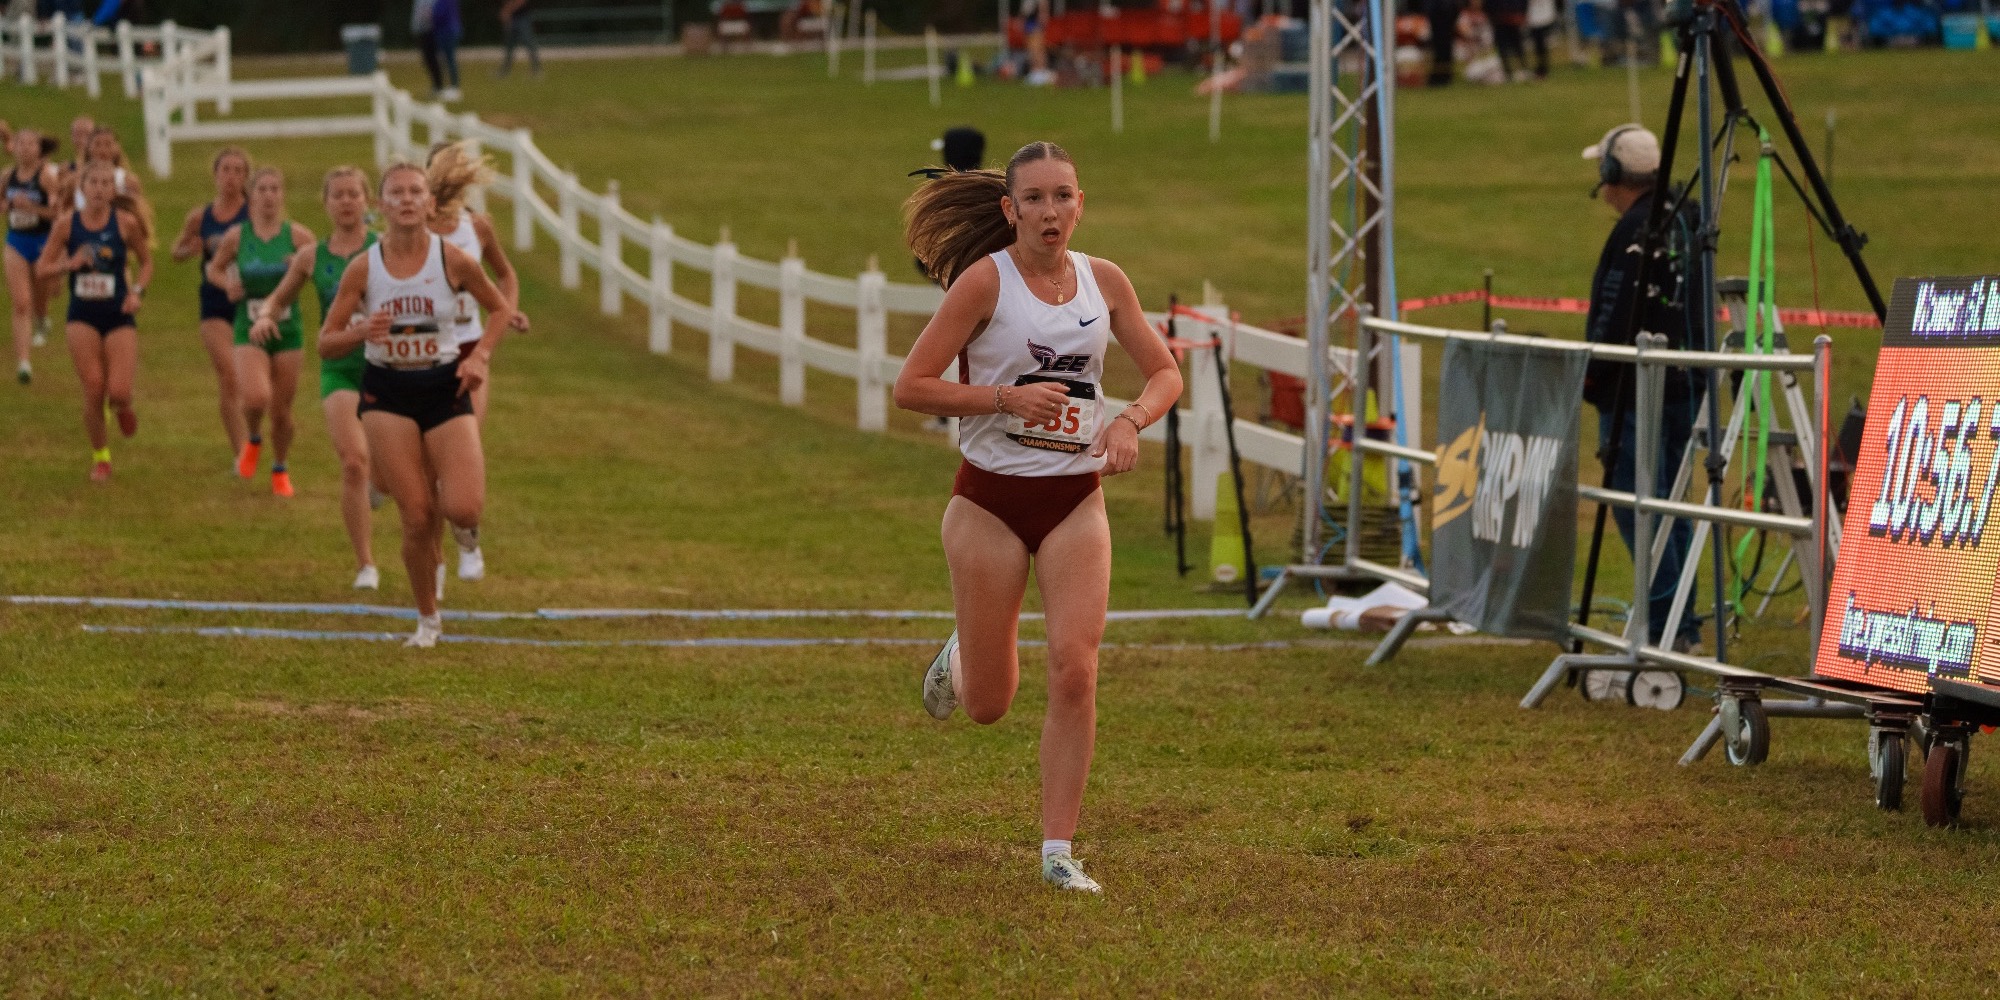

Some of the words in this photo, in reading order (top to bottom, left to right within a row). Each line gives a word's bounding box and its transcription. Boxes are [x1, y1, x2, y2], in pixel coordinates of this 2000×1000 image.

[384, 340, 438, 358] 1016
[1039, 354, 1092, 374] LEE
[1018, 437, 1081, 453] CHAMPIONSHIPS
